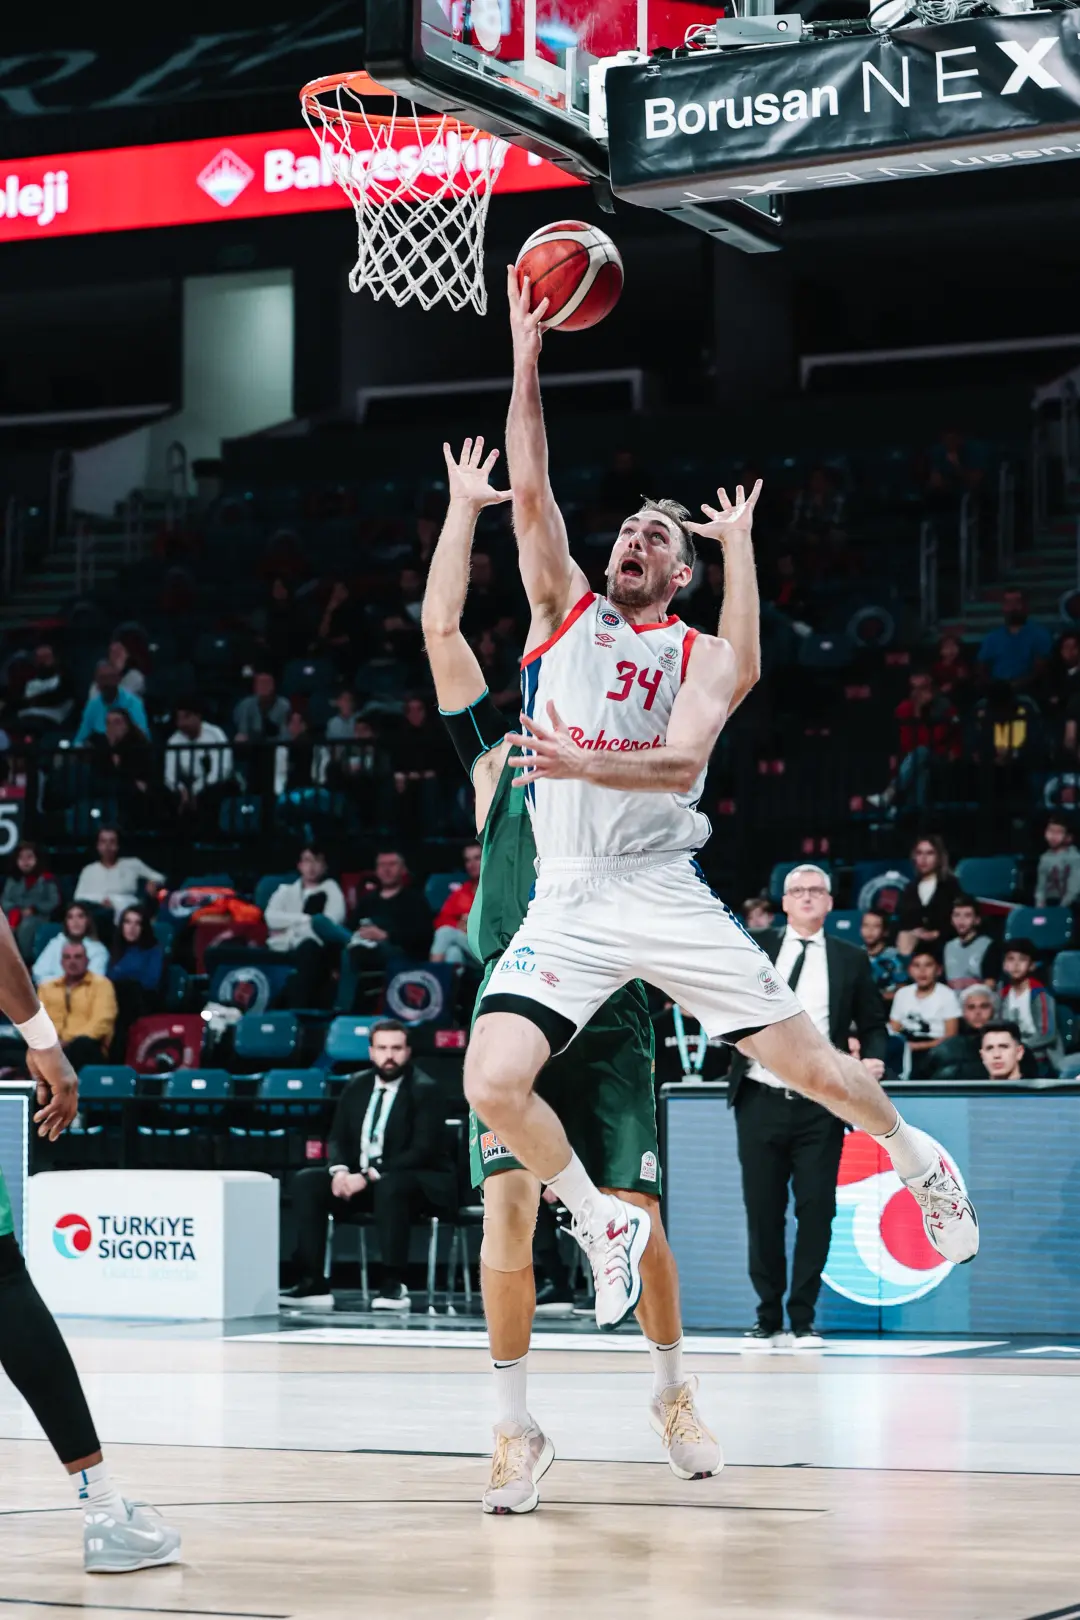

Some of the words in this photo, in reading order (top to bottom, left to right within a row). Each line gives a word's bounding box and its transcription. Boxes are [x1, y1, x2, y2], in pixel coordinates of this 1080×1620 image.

[644, 84, 839, 140] Borusan
[862, 32, 1080, 113] NEX
[606, 660, 664, 711] 34
[500, 960, 536, 973] BAU
[98, 1215, 195, 1237] TÜRKİYE
[98, 1239, 196, 1261] SİGORTA
